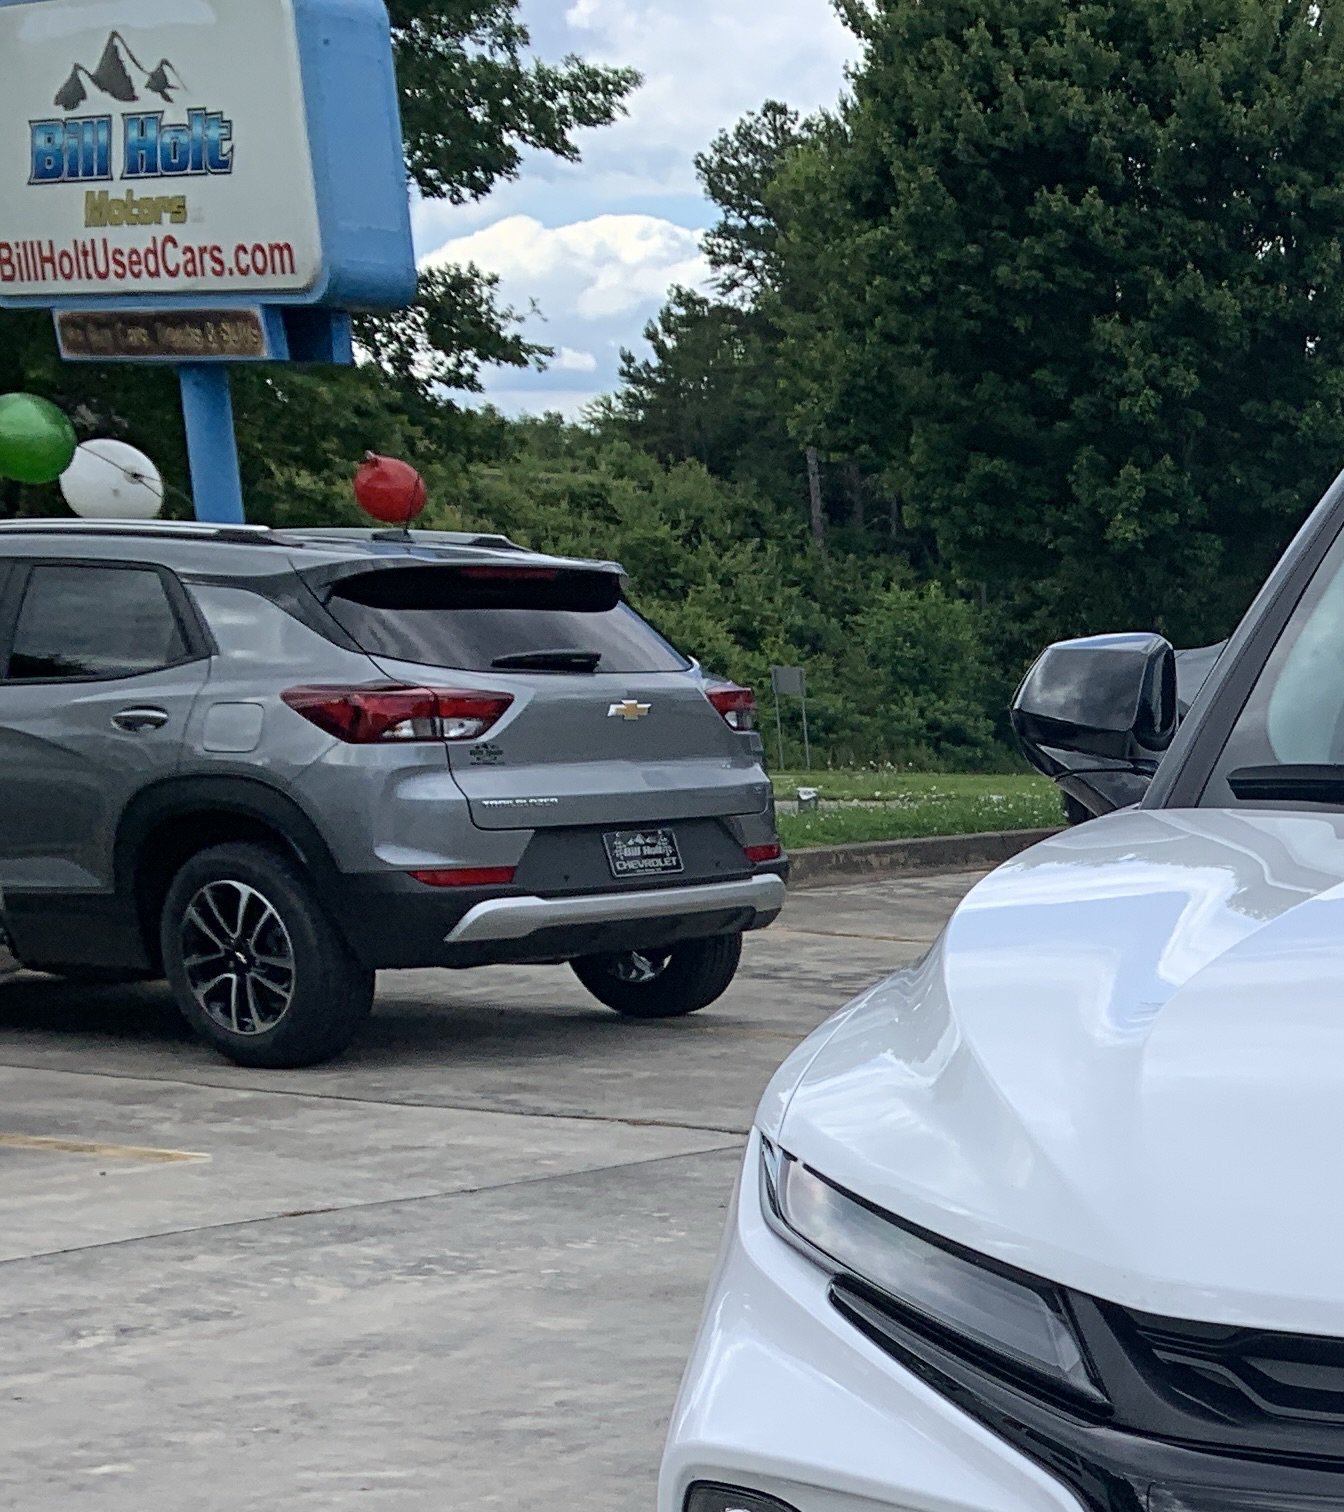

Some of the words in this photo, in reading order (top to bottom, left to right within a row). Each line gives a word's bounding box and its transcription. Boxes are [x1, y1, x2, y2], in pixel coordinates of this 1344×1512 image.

[27, 114, 113, 185] Bill
[120, 106, 234, 180] Holt
[85, 189, 188, 228] Motors
[0, 234, 297, 283] BillHoltUsedCars.com
[615, 857, 677, 870] CHEVROLET
[623, 846, 641, 857] Bill
